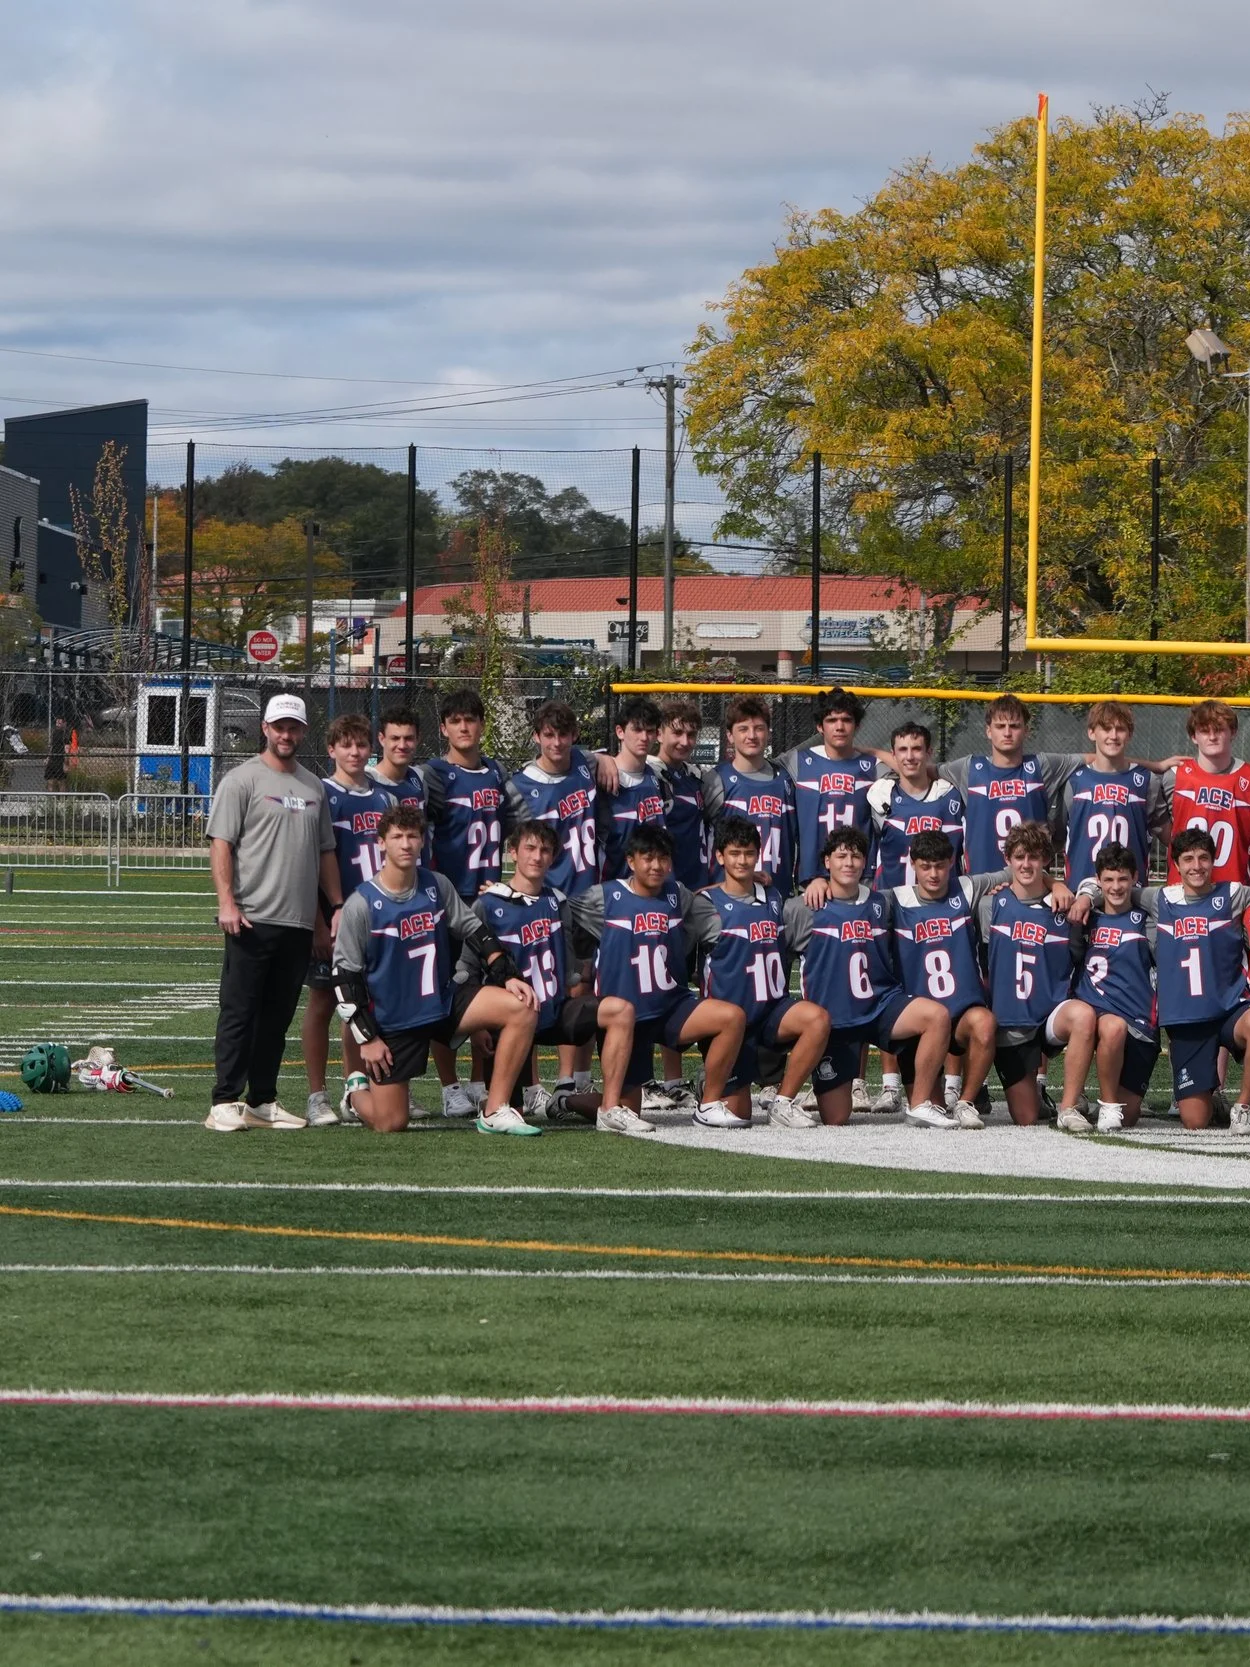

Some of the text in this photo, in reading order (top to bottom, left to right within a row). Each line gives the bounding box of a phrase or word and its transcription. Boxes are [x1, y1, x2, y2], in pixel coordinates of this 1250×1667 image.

[819, 773, 855, 794] ACE
[988, 779, 1026, 800] ACE
[1093, 783, 1128, 806] ACE
[283, 796, 305, 810] ACE
[558, 789, 590, 820] ACE
[637, 796, 664, 823] ACE
[748, 795, 782, 817] ACE
[1195, 786, 1233, 811] ACE
[905, 816, 942, 835] ACE
[995, 808, 1022, 850] 9
[1088, 814, 1129, 862] 20
[563, 818, 596, 873] 18
[400, 911, 434, 941] ACE
[521, 918, 551, 946] ACE
[633, 912, 669, 934] ACE
[750, 920, 778, 943] ACE
[841, 919, 875, 942] ACE
[914, 918, 952, 944] ACE
[1012, 921, 1047, 945] ACE
[1174, 917, 1208, 940] ACE
[1090, 927, 1122, 947] ACE
[408, 943, 437, 996] 7
[746, 952, 786, 1001] 10
[849, 951, 874, 999] 6
[924, 950, 955, 999] 8
[1015, 952, 1036, 1000] 5
[1181, 948, 1202, 996] 1
